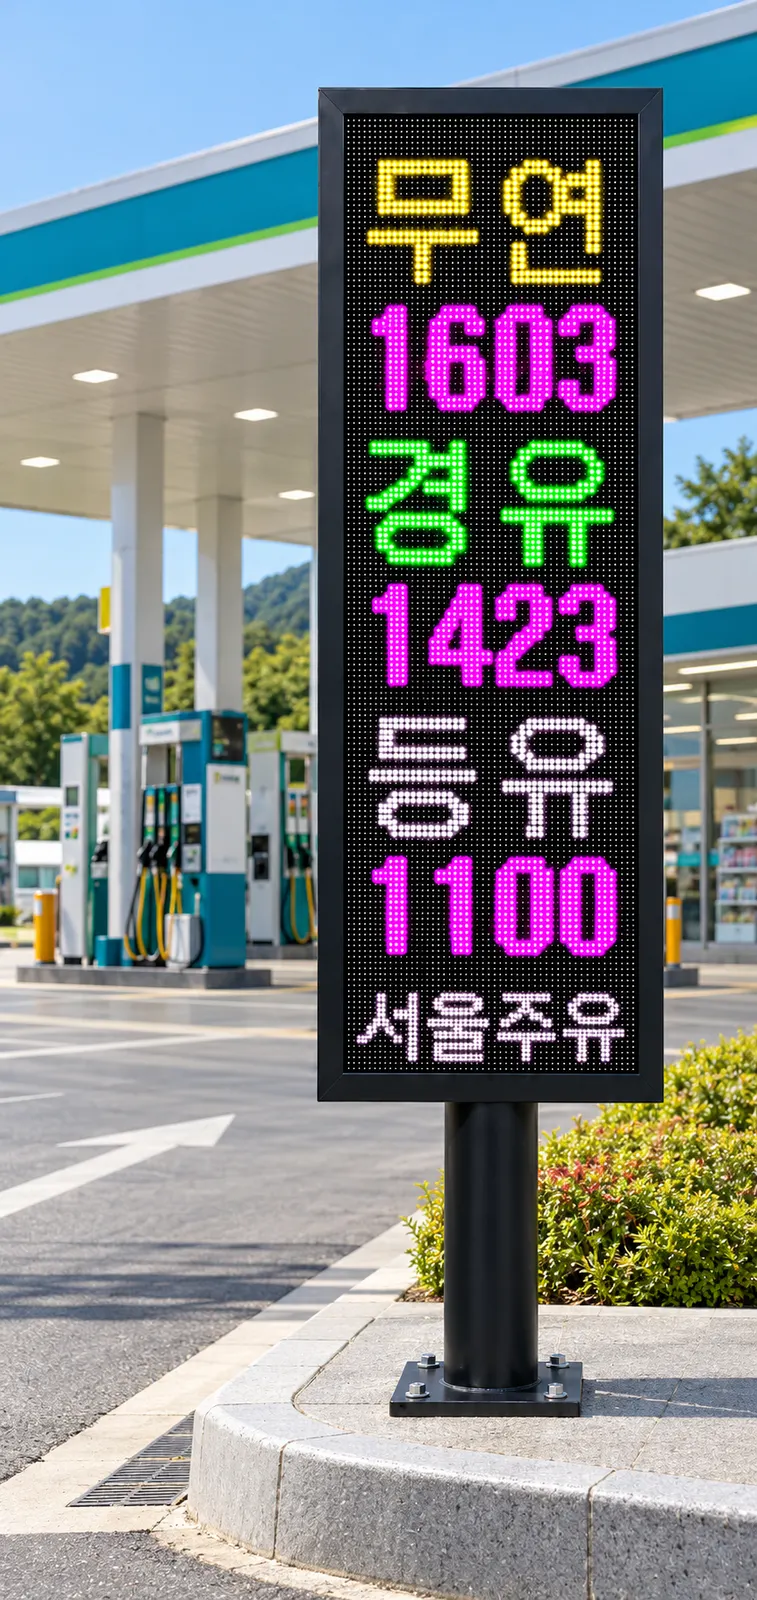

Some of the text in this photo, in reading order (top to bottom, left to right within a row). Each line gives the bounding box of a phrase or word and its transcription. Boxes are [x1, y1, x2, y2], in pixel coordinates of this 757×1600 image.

[366, 159, 602, 285] 무연
[371, 303, 617, 413] 1603
[365, 439, 615, 568] 경유
[371, 582, 618, 688] 1423
[368, 716, 613, 839] 등유
[371, 855, 618, 957] 1100
[357, 992, 625, 1062] 서울주유
